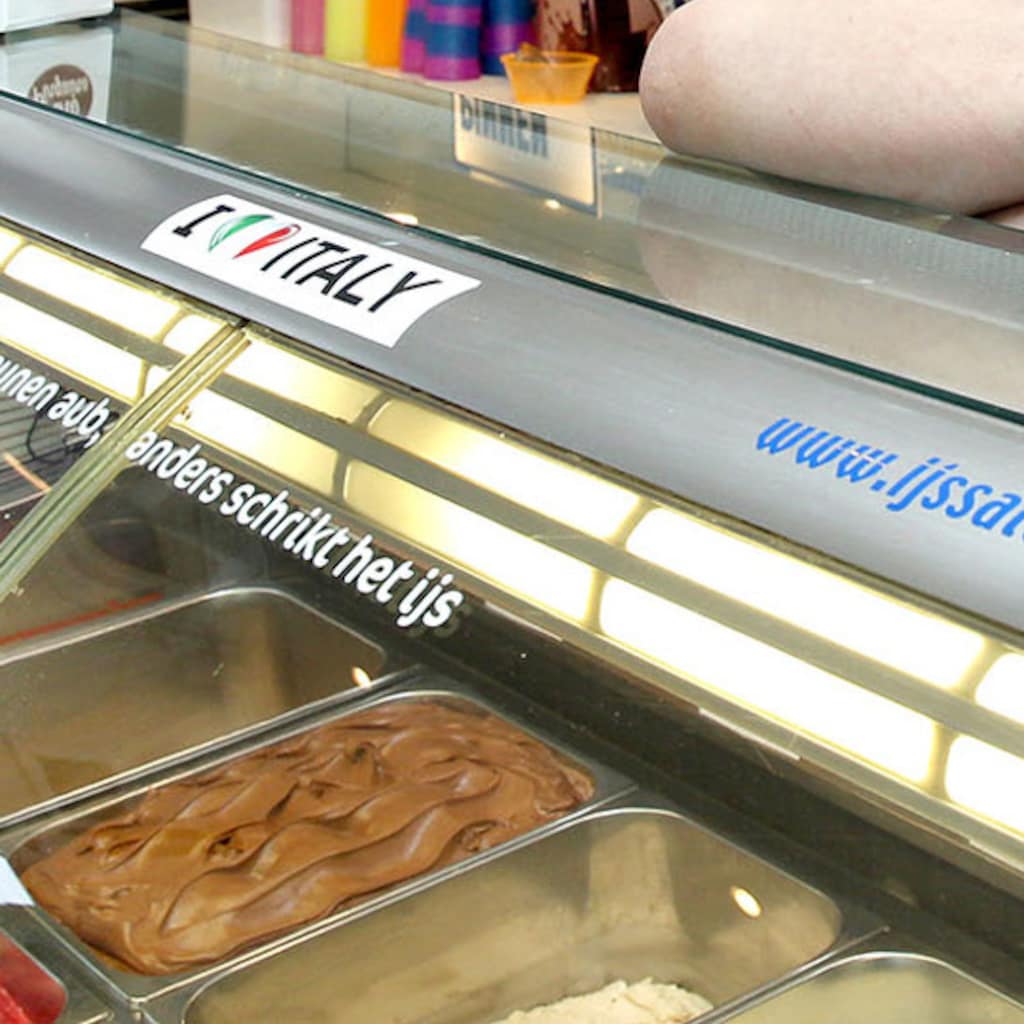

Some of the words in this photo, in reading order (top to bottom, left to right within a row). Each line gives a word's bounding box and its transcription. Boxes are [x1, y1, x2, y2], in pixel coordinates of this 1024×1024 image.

[172, 204, 234, 238] I
[260, 236, 443, 314] ITALY
[0, 355, 60, 411] unen
[47, 392, 110, 449] aub,
[126, 430, 237, 504] anders
[220, 490, 351, 568] schrikt
[332, 534, 415, 603] het
[397, 567, 465, 628] ijs
